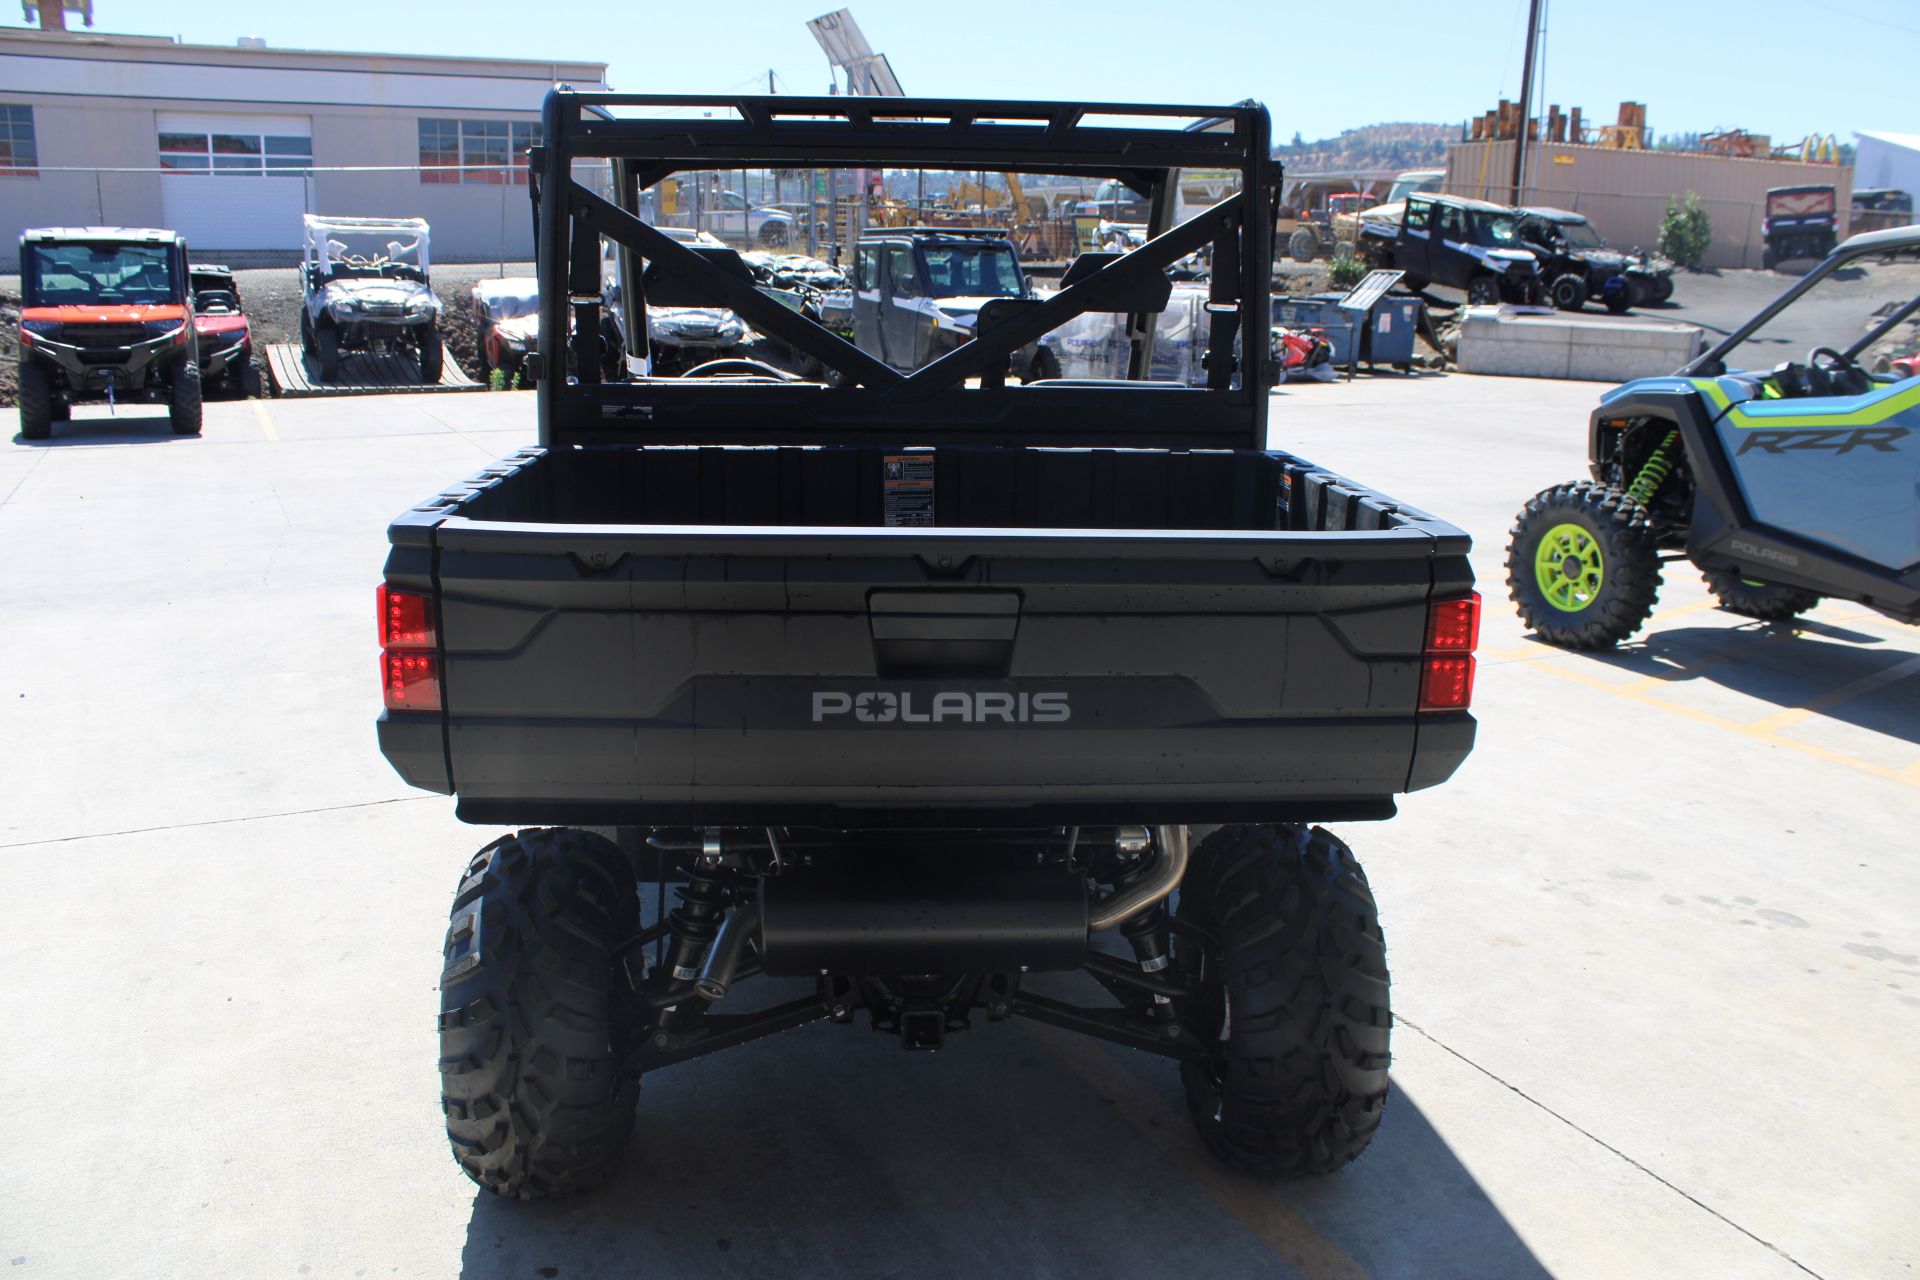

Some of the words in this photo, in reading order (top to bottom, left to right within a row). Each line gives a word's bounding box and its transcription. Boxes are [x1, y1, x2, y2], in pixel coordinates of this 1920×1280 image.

[1736, 427, 1911, 456] RZR
[1731, 540, 1799, 566] POLARIS
[812, 692, 1071, 722] POLARIS
